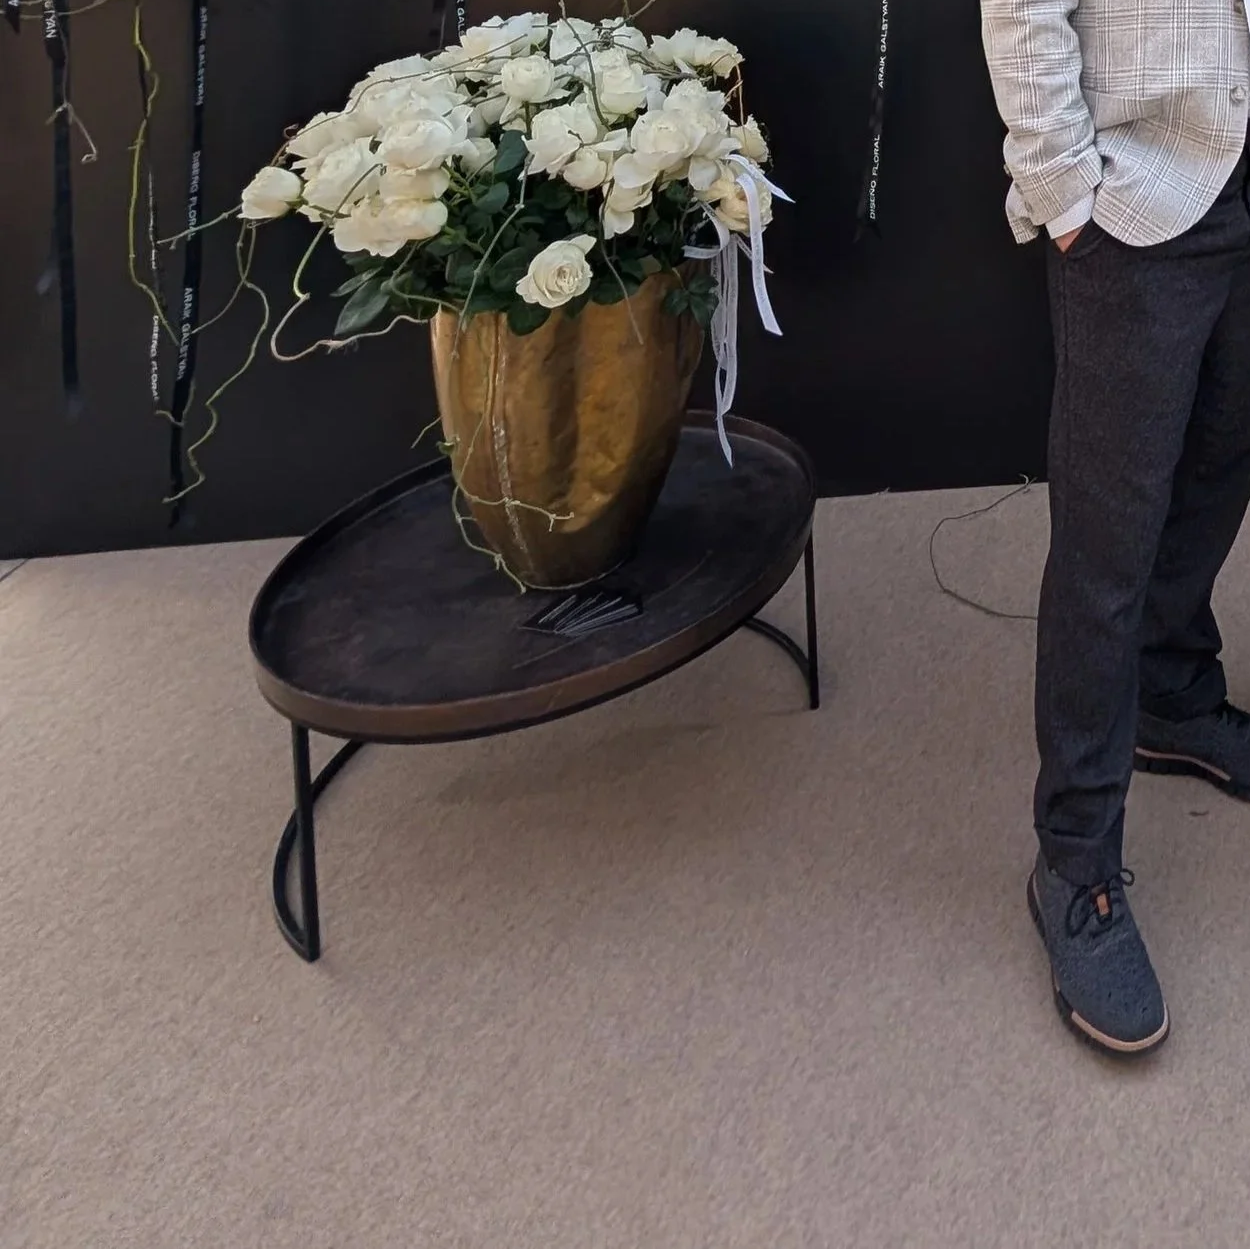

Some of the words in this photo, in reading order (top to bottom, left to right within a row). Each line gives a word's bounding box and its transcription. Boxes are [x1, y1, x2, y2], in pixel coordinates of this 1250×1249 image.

[457, 8, 466, 37] GALS
[878, 56, 887, 89] ARAIK
[872, 135, 881, 176] FLORAL
[869, 180, 877, 220] DISEÑO
